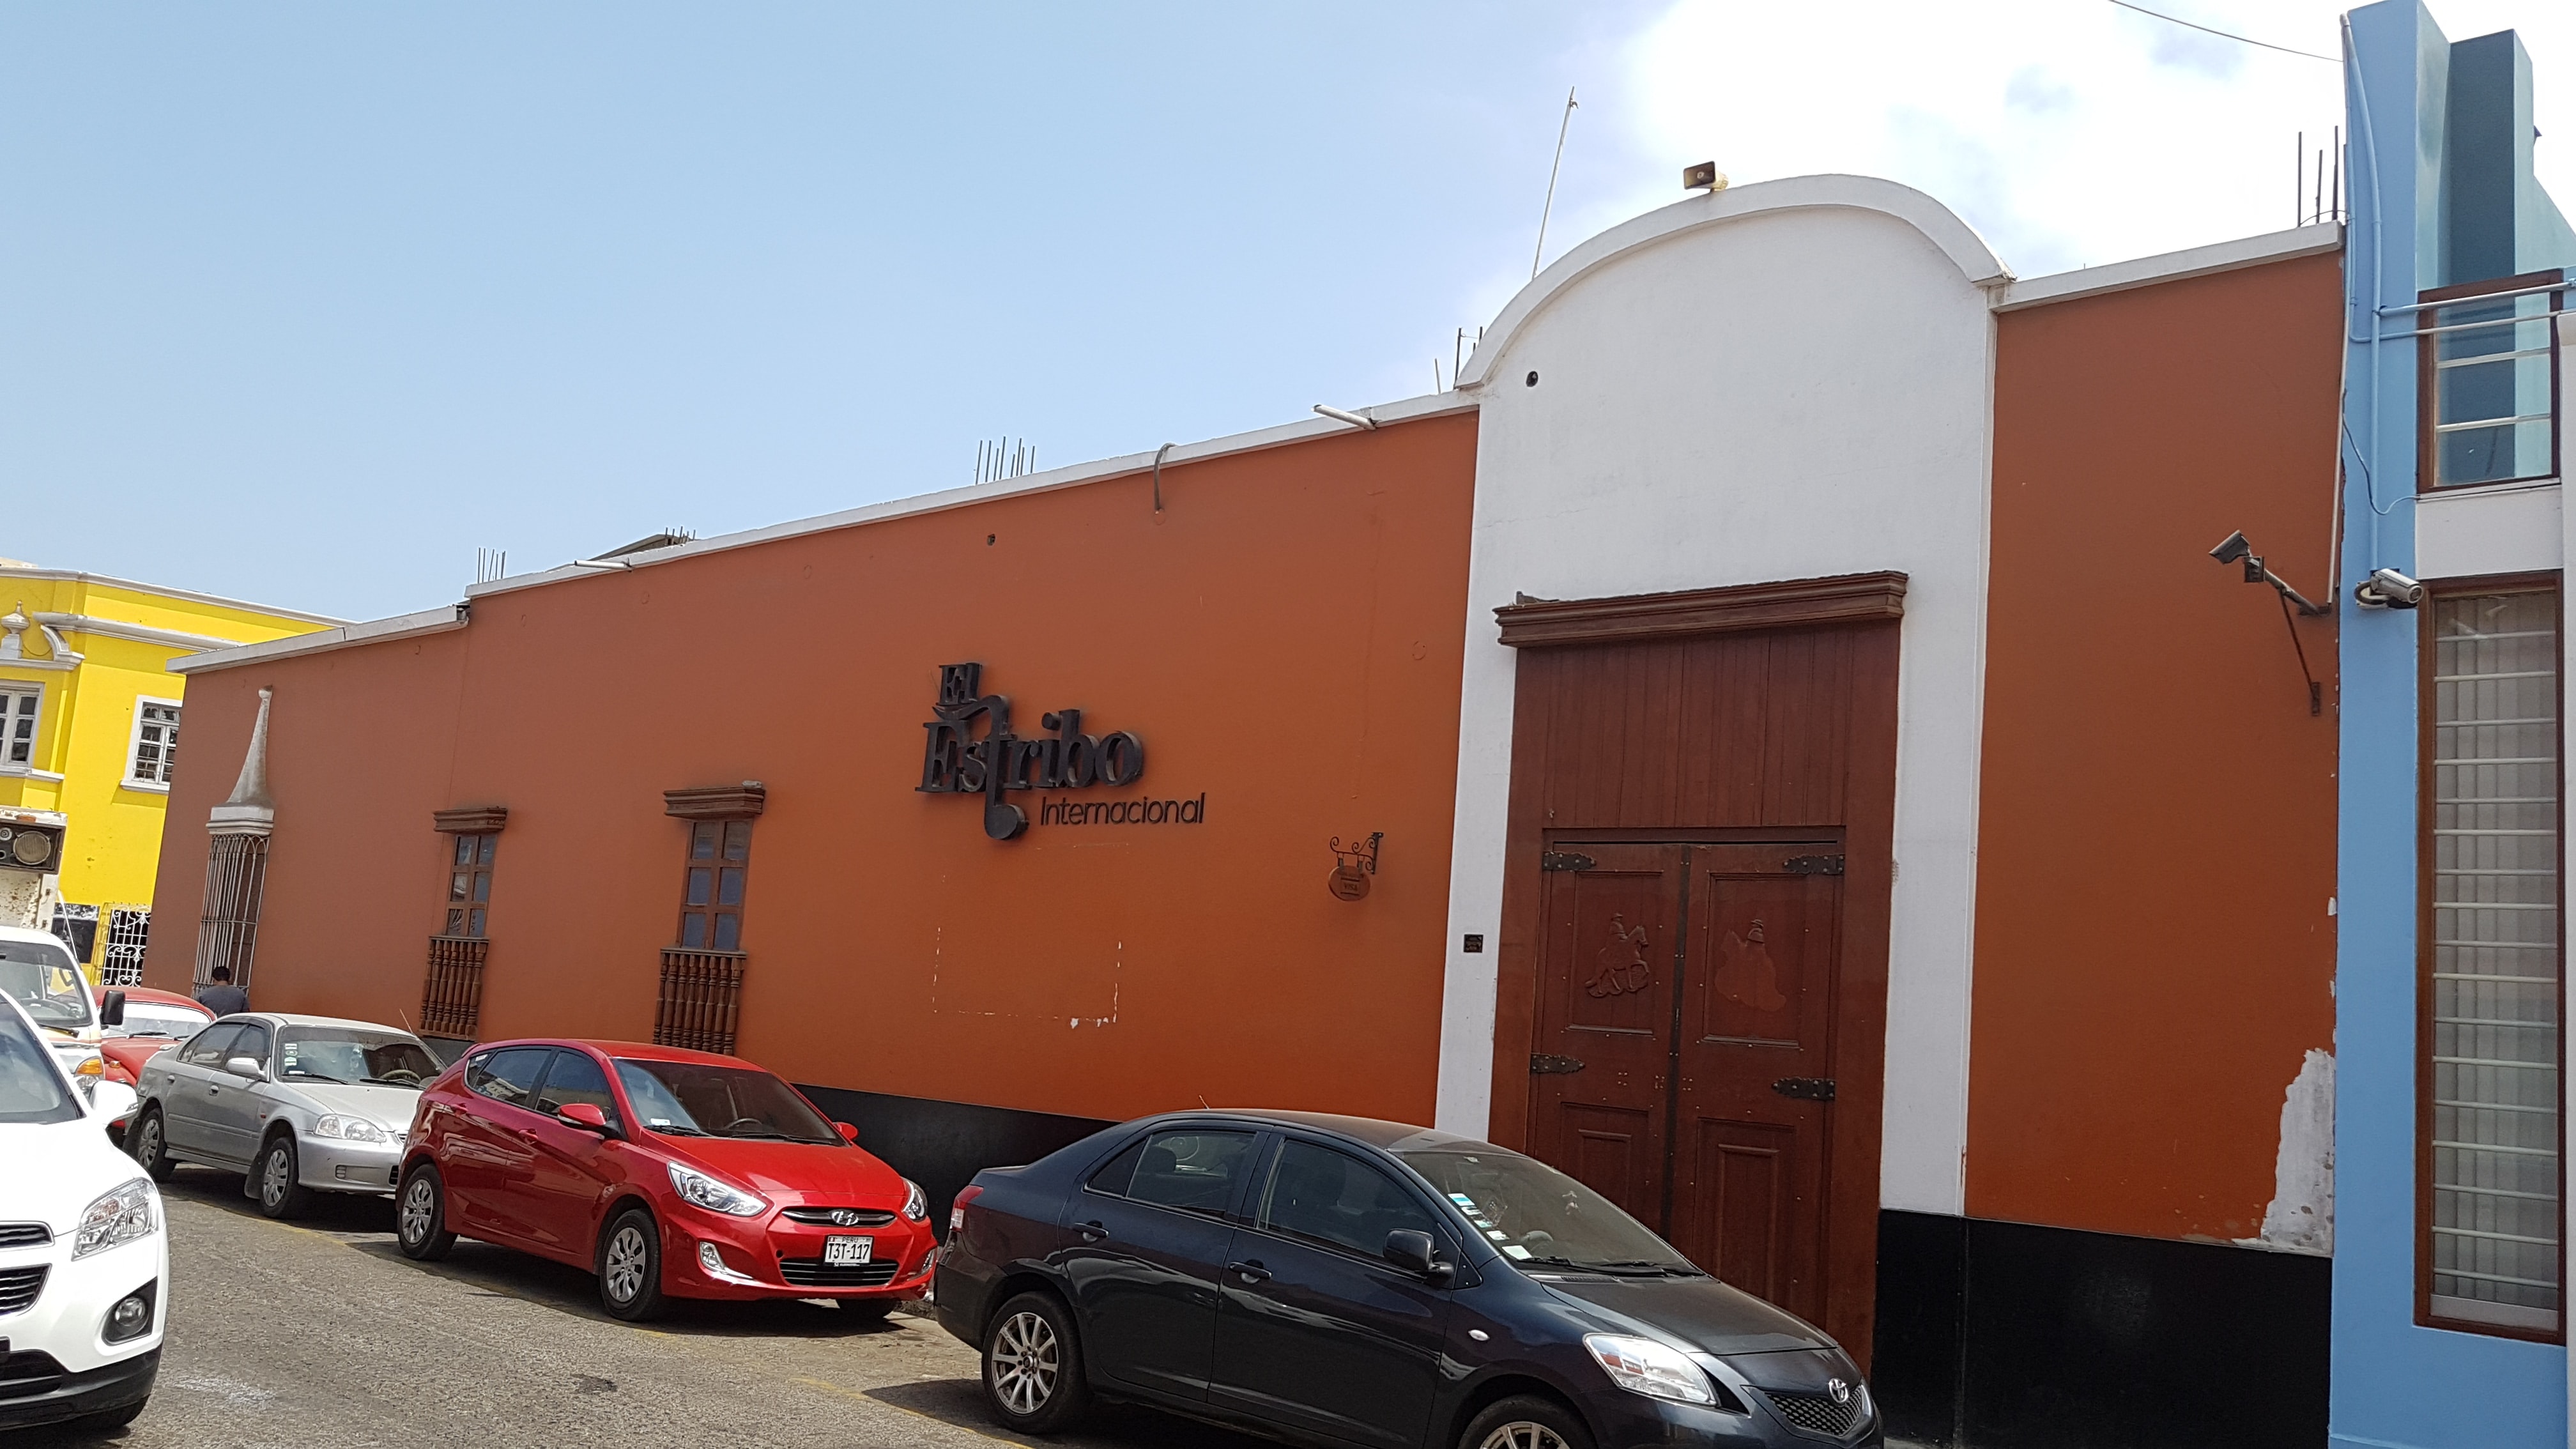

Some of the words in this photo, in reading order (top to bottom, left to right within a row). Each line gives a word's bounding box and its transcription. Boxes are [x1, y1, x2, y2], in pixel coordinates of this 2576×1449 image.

[939, 662, 983, 706] El
[915, 695, 1144, 840] Estribo
[1040, 792, 1206, 825] Internacional
[828, 1243, 870, 1260] T3T-117
